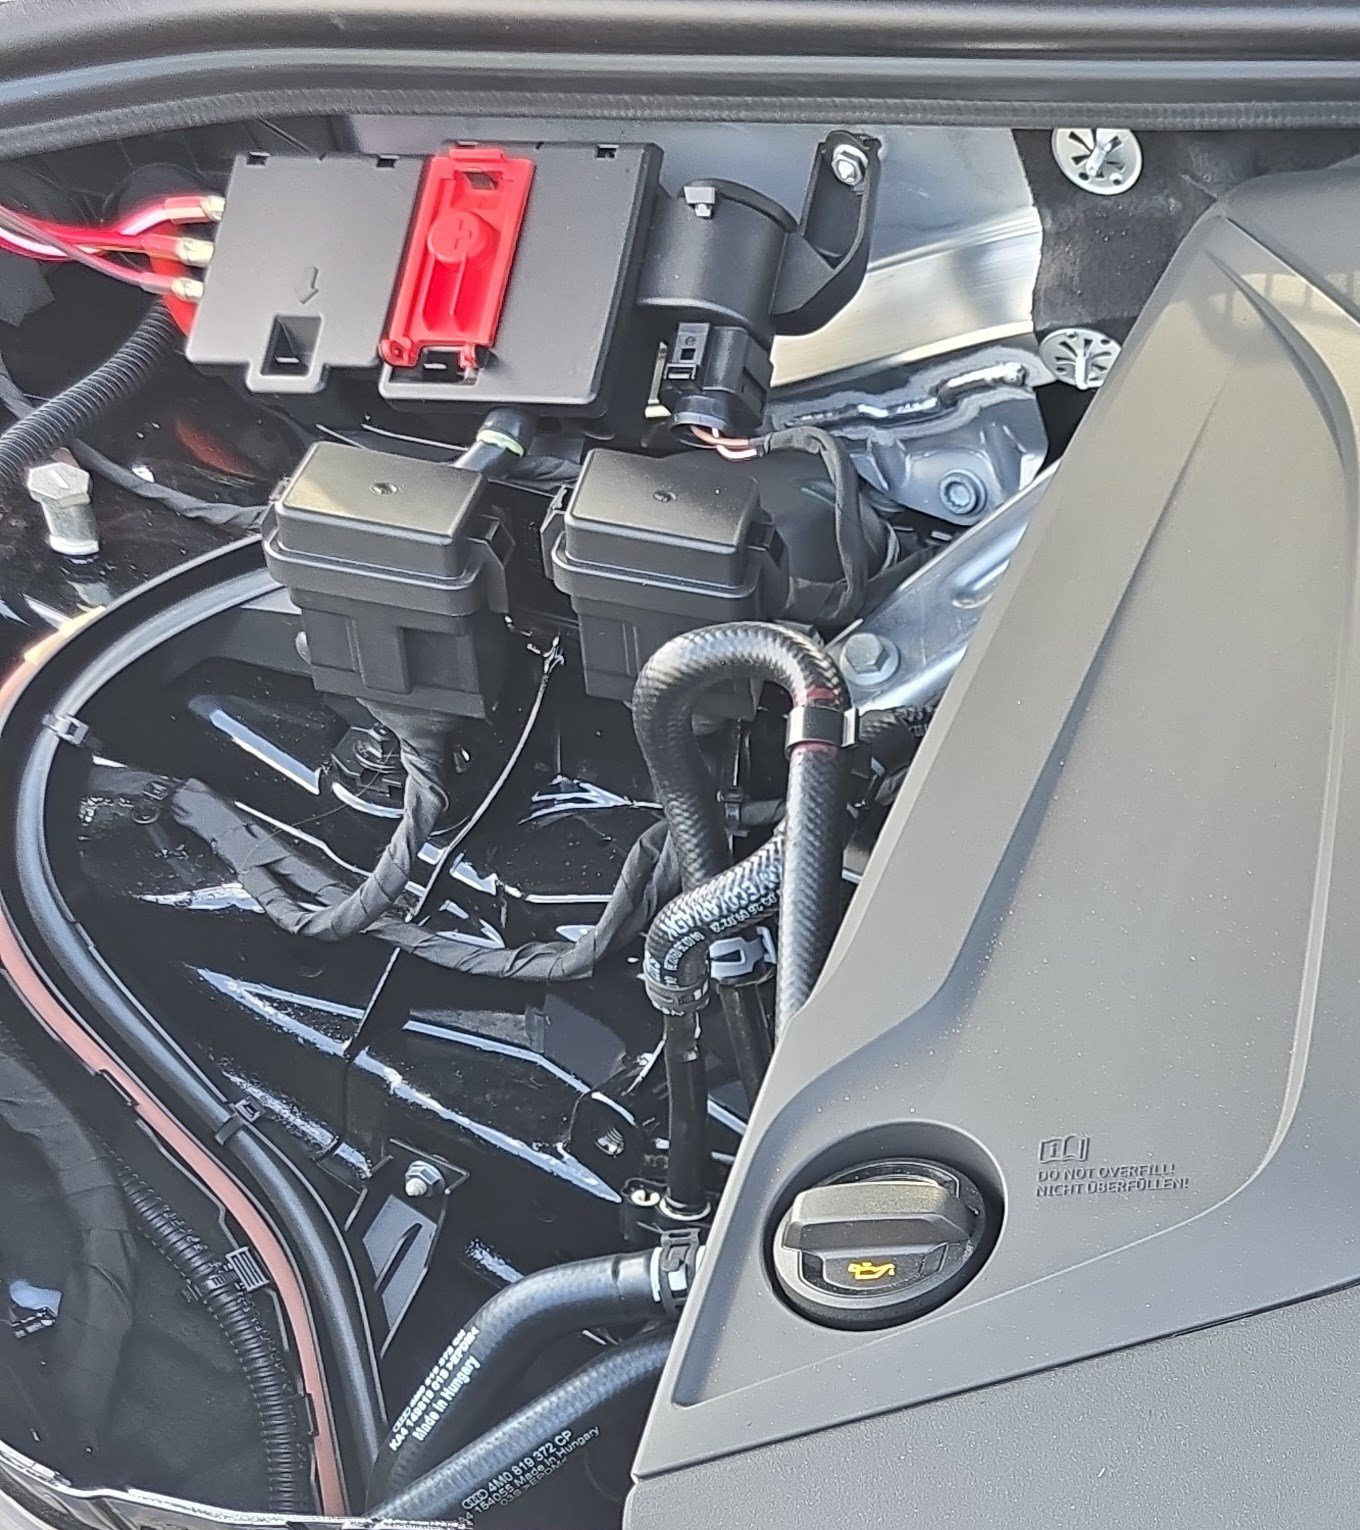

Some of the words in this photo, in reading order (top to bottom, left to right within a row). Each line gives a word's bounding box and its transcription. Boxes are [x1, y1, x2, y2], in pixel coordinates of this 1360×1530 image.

[1035, 1182, 1083, 1197] NICHT
[1038, 1169, 1060, 1181] DO
[1062, 1167, 1095, 1180] NOT
[412, 1410, 440, 1441] Made
[441, 1355, 481, 1401] Hungary
[511, 1457, 535, 1475] 819
[532, 1442, 557, 1462] 372
[554, 1429, 573, 1447] CP
[514, 1464, 545, 1487] Made
[557, 1426, 601, 1460] Hungary
